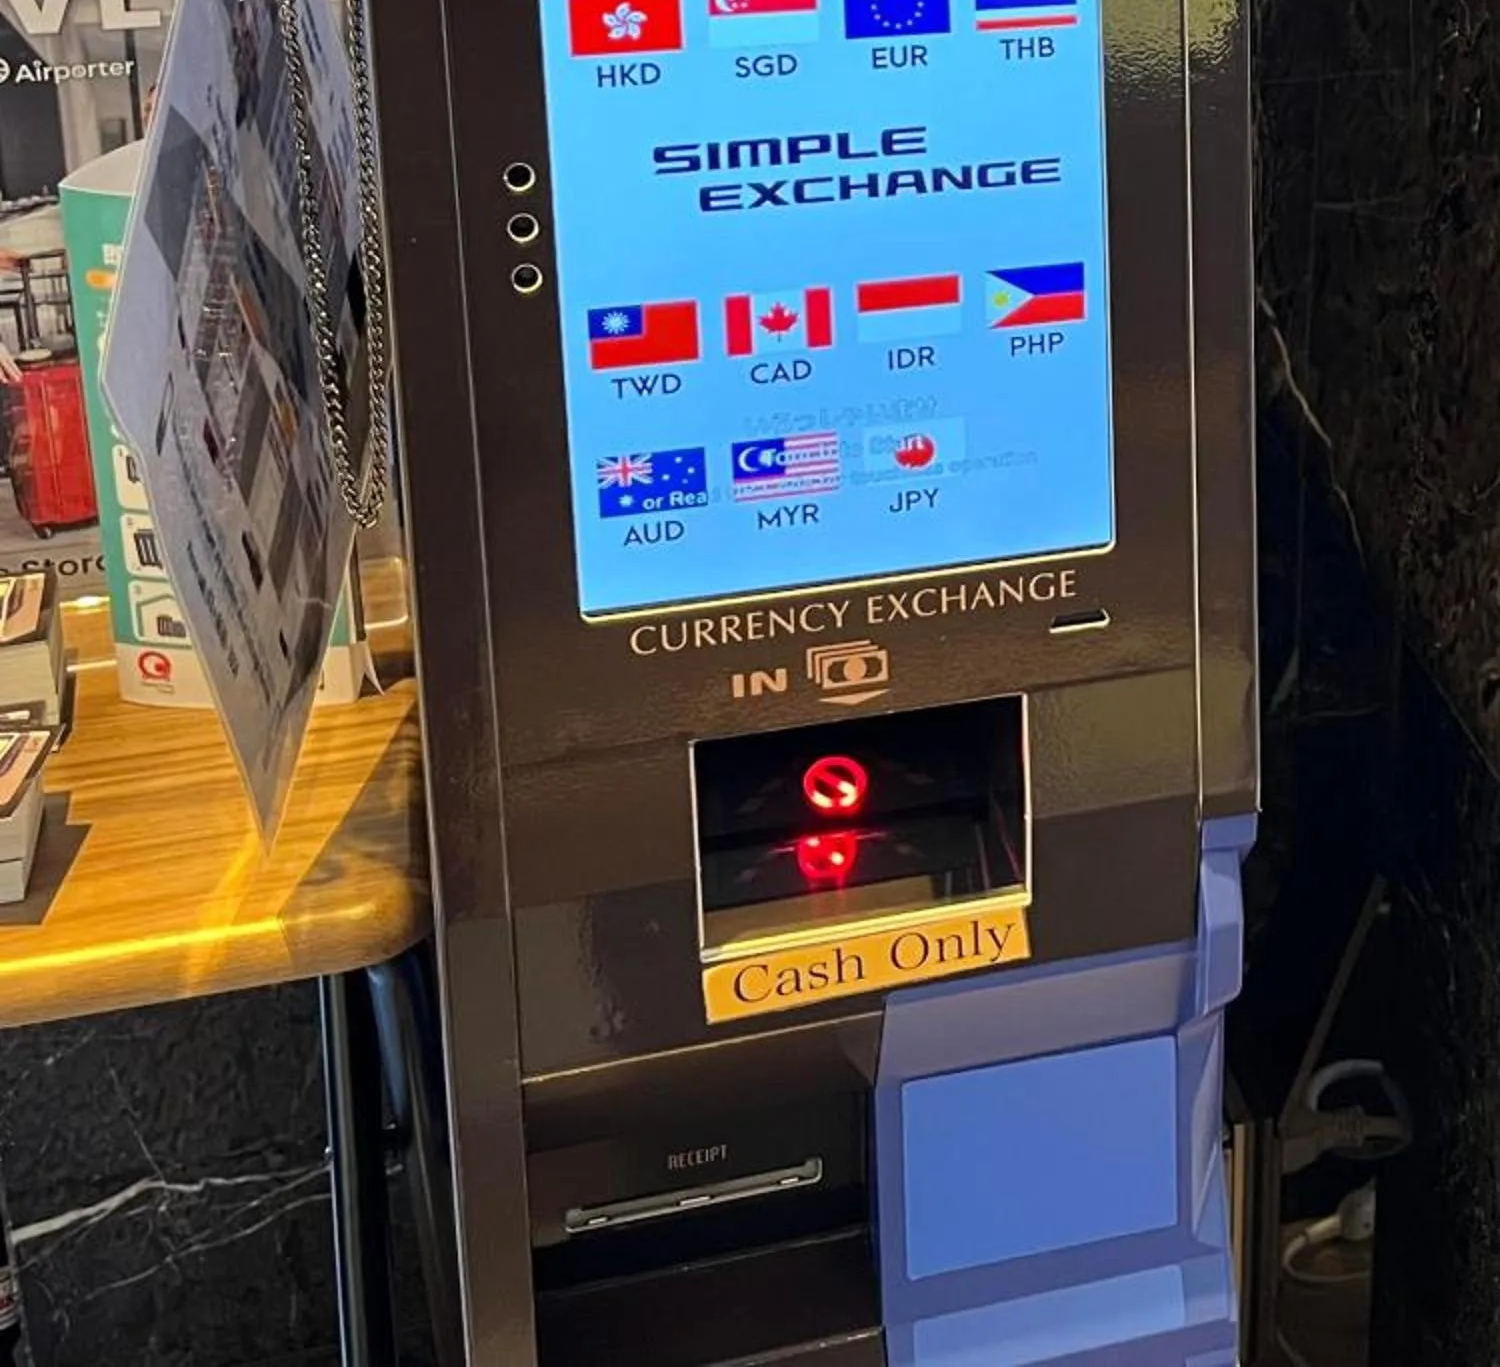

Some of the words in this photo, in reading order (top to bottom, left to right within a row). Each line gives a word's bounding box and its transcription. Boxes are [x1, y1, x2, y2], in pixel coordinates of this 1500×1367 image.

[15, 59, 135, 84] Airporter
[596, 63, 661, 88] HKD
[735, 54, 798, 79] SGD
[872, 46, 928, 69] EUR
[1000, 38, 1054, 60] THB
[653, 126, 927, 175] SIMPLE
[700, 158, 1061, 211] EXCHANGE
[611, 373, 682, 399] TWD
[750, 360, 812, 384] CAD
[888, 346, 935, 371] IDR
[1010, 333, 1064, 357] PHP
[622, 520, 685, 547] AUD
[757, 503, 819, 530] MYR
[889, 488, 939, 513] JPY
[630, 601, 851, 655] CURRENCY
[867, 570, 1077, 624] EXCHANGE
[731, 668, 787, 697] IN
[733, 946, 864, 1006] Cash
[890, 917, 1015, 972] Only
[667, 1144, 728, 1169] RECEIPT
